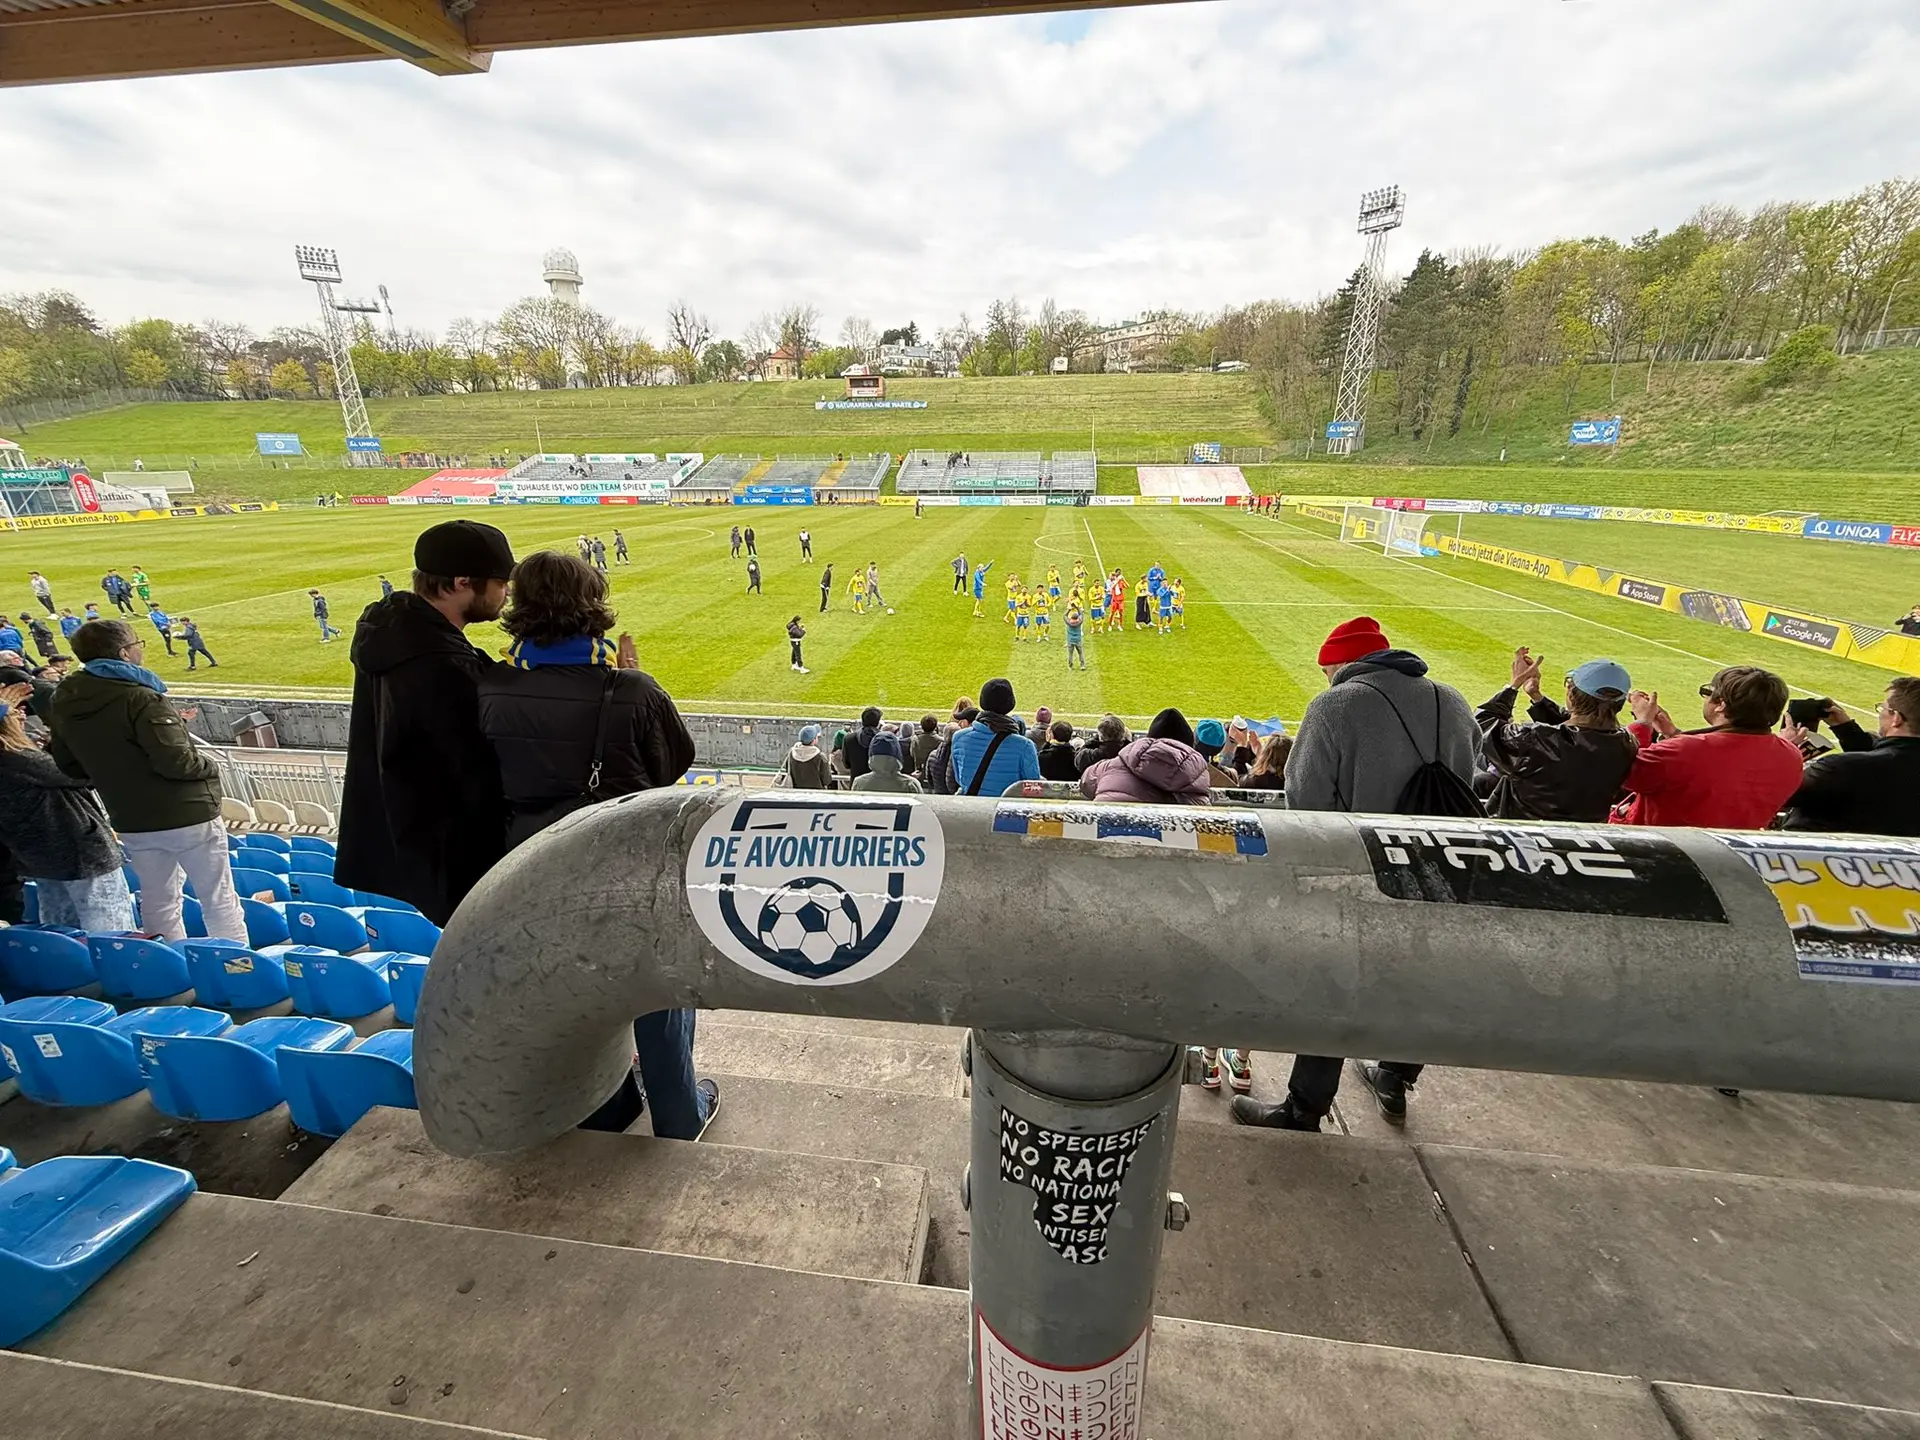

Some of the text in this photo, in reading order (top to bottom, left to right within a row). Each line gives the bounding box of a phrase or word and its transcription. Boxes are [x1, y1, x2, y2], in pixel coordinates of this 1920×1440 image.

[517, 483, 647, 491] ZUHAUSE IST, WO DEIN TEAM SPIELT
[572, 496, 598, 504] NIEDAX
[1183, 496, 1222, 504] weekend
[29, 517, 52, 529] jetzt
[54, 515, 67, 524] die
[69, 511, 120, 524] Vienna-App
[1834, 524, 1880, 539] UNIQA
[1448, 539, 1550, 578] Hot euch jetzt die Vienna-App
[1630, 588, 1660, 603] App Store
[1783, 624, 1832, 646] Google Play
[810, 813, 837, 832] FC
[705, 835, 926, 868] DE AVONTURIERS
[1001, 1109, 1156, 1154] NO SPECIESIS
[1001, 1130, 1041, 1166] NO
[1001, 1154, 1121, 1200] NO NATIONA
[1051, 1201, 1121, 1226] SEX
[1049, 1242, 1110, 1265] ASC
